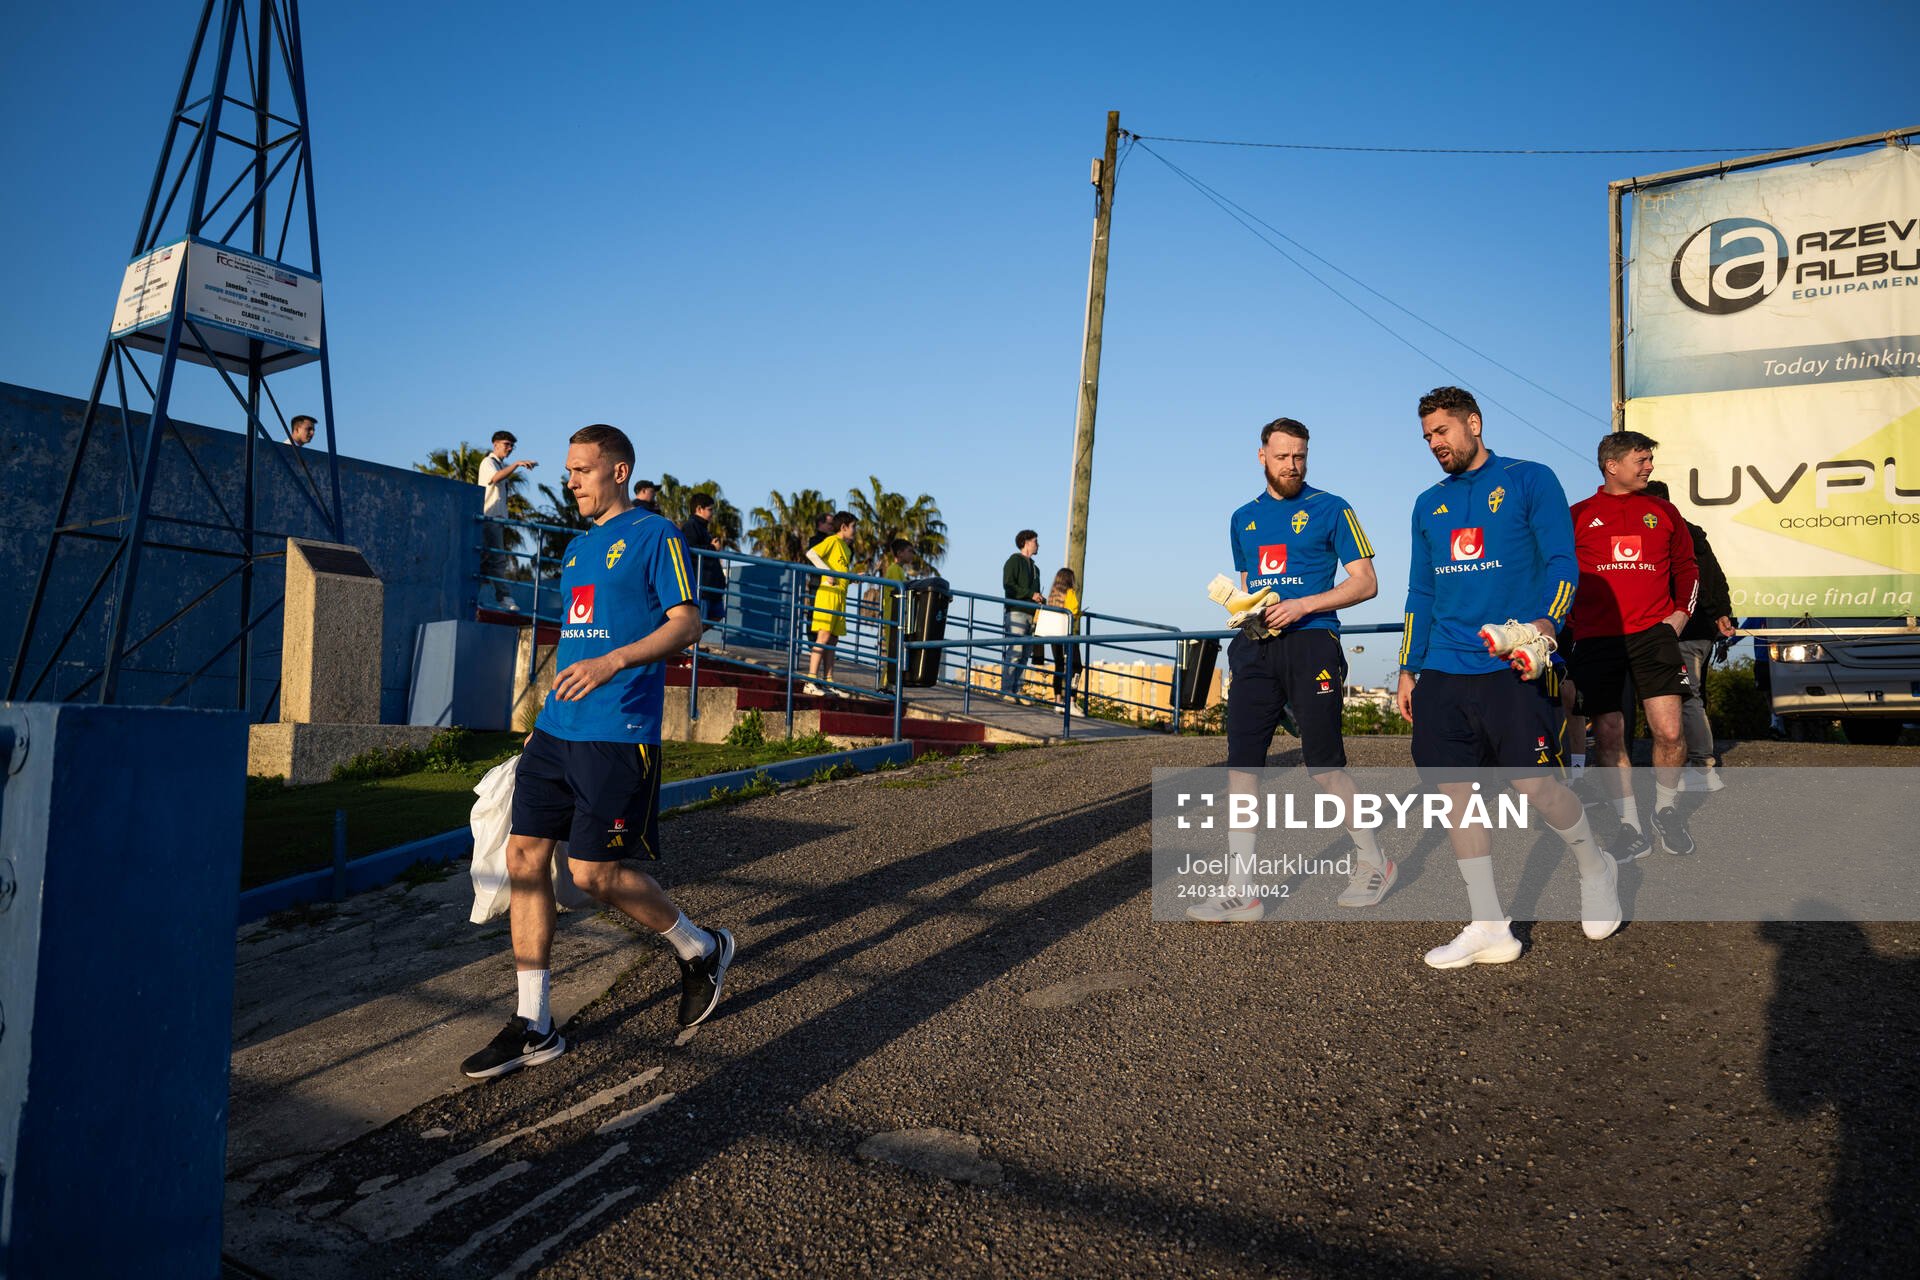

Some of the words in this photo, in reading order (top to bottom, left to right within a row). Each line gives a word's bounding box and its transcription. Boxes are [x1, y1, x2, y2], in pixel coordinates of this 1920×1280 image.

[1796, 218, 1920, 255] AZEV
[1796, 248, 1920, 284] ALBU
[1792, 276, 1918, 300] EQUIPAMEN
[1763, 357, 1829, 377] Today
[1835, 348, 1920, 371] thinkin
[1780, 511, 1920, 529] acabamentos
[1435, 564, 1479, 575] SVENSKA
[1480, 560, 1503, 571] SPEL
[1596, 562, 1637, 571] SVENSKA
[1638, 563, 1657, 571] SPEL
[1281, 576, 1304, 585] SPEL
[1754, 590, 1817, 609] toque
[1824, 587, 1877, 606] final
[1882, 591, 1913, 606] na
[561, 629, 585, 639] ENSKA
[586, 628, 611, 639] SPEL
